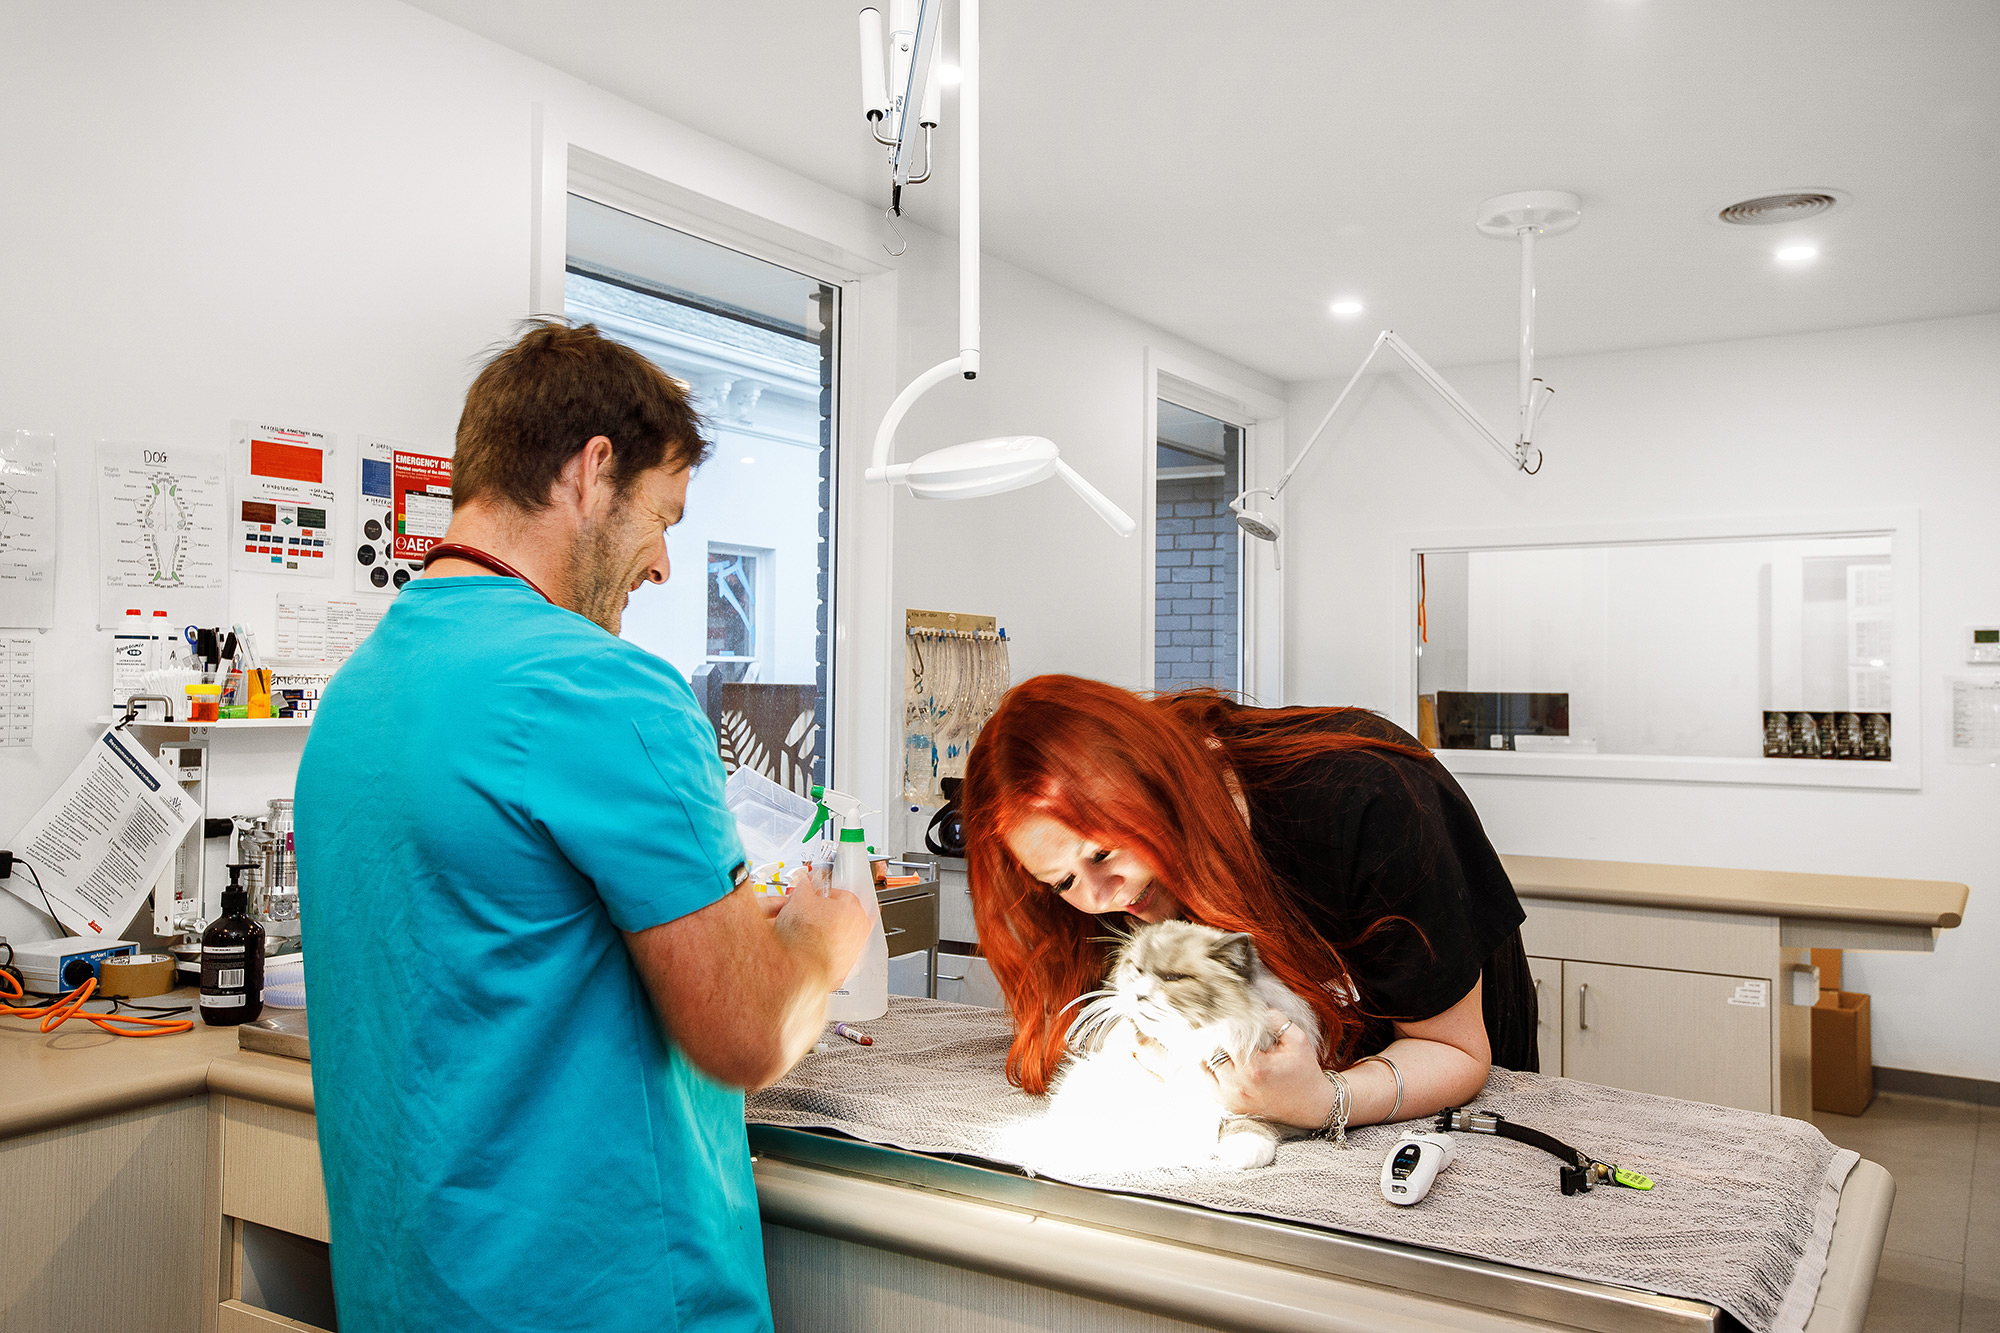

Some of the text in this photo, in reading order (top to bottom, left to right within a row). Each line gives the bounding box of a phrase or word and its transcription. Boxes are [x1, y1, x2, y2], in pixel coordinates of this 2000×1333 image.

[144, 450, 167, 463] DOG
[396, 454, 439, 468] EMERGENCY
[406, 538, 433, 552] AEC
[106, 737, 136, 768] Recommended
[133, 764, 157, 788] Procedures
